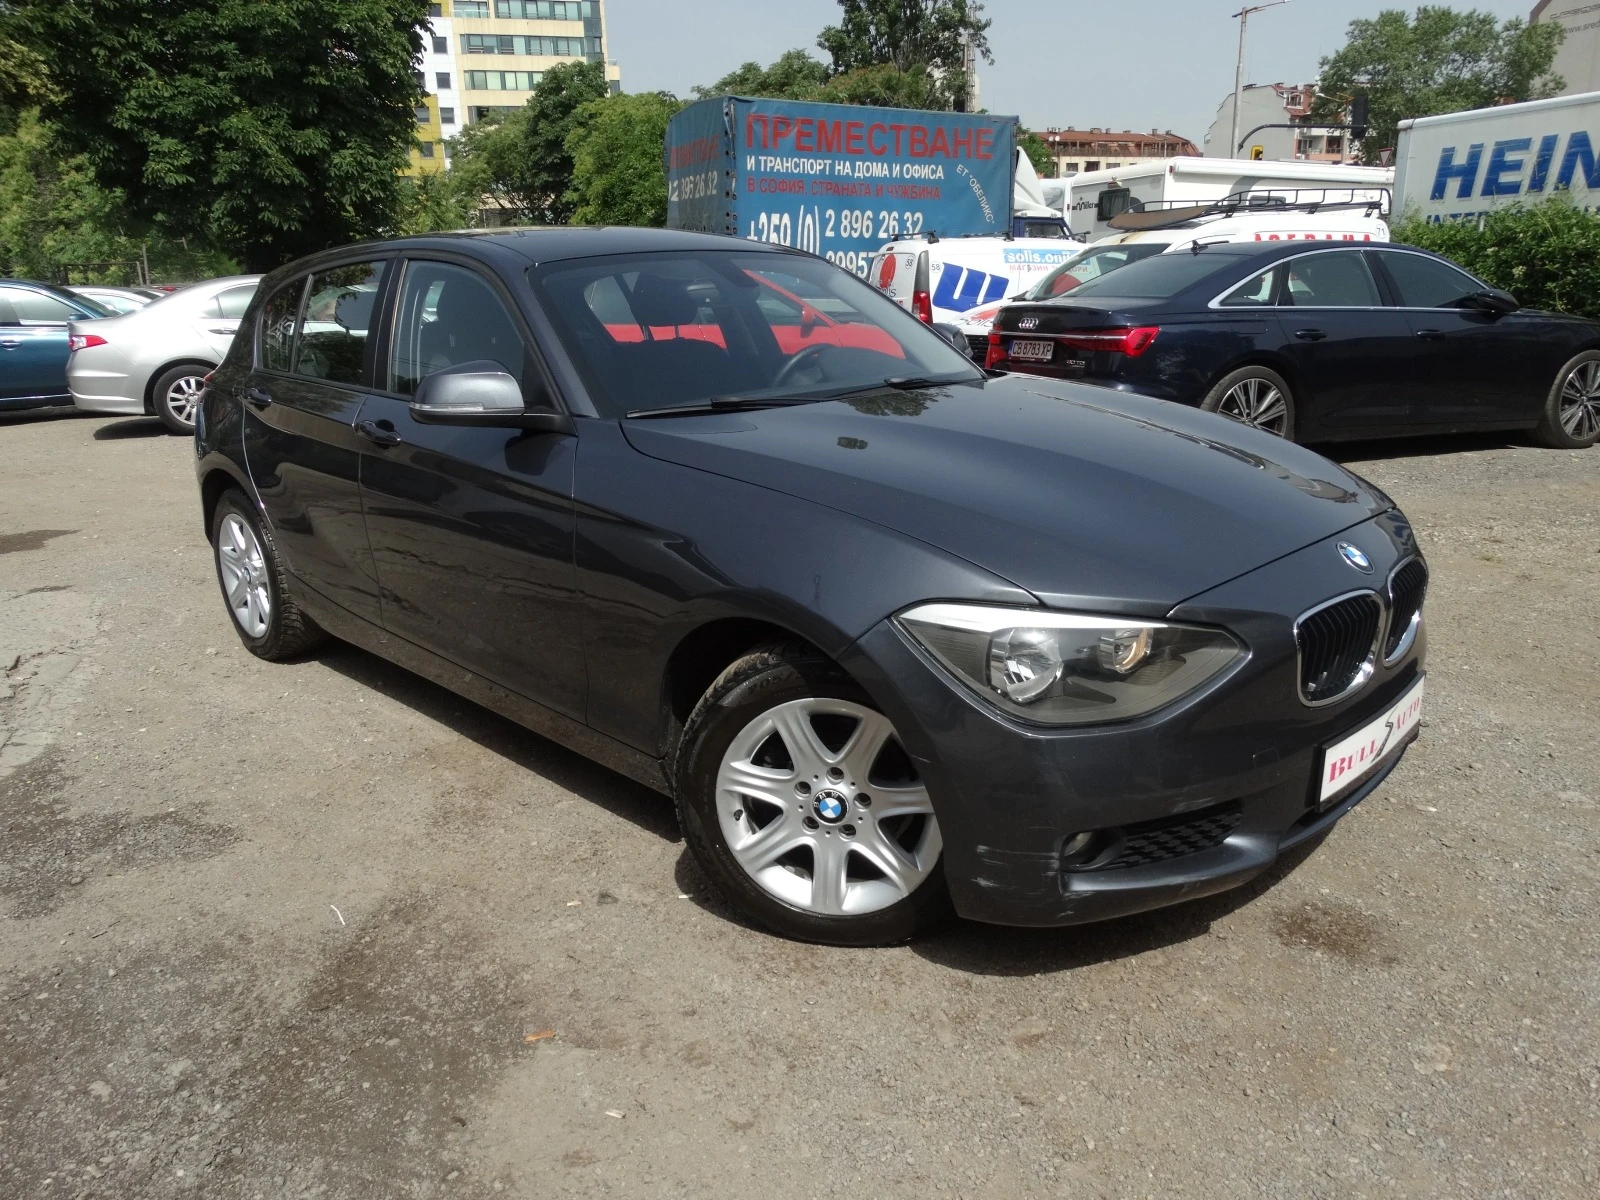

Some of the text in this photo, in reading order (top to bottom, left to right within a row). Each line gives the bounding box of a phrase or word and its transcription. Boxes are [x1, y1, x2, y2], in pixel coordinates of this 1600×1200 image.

[745, 113, 994, 160] ПРЕМЕСТВАНЕ
[746, 155, 944, 180] И ТРАНСПОРТ НА ДОМА И ОФИСА
[956, 164, 969, 176] ЕТ
[707, 170, 718, 196] 32
[747, 178, 756, 192] В
[811, 180, 871, 198] СТРАНАТА
[875, 183, 883, 198] И
[886, 184, 941, 200] ЧУЖБИНА
[825, 208, 835, 238] 2
[840, 209, 873, 238] 896
[877, 210, 899, 238] 26
[903, 212, 923, 238] 32
[1376, 228, 1386, 236] 71
[906, 258, 914, 267] 58
[1012, 342, 1052, 356] CB 8783 XP
[1328, 696, 1420, 783] BULL AUTO
